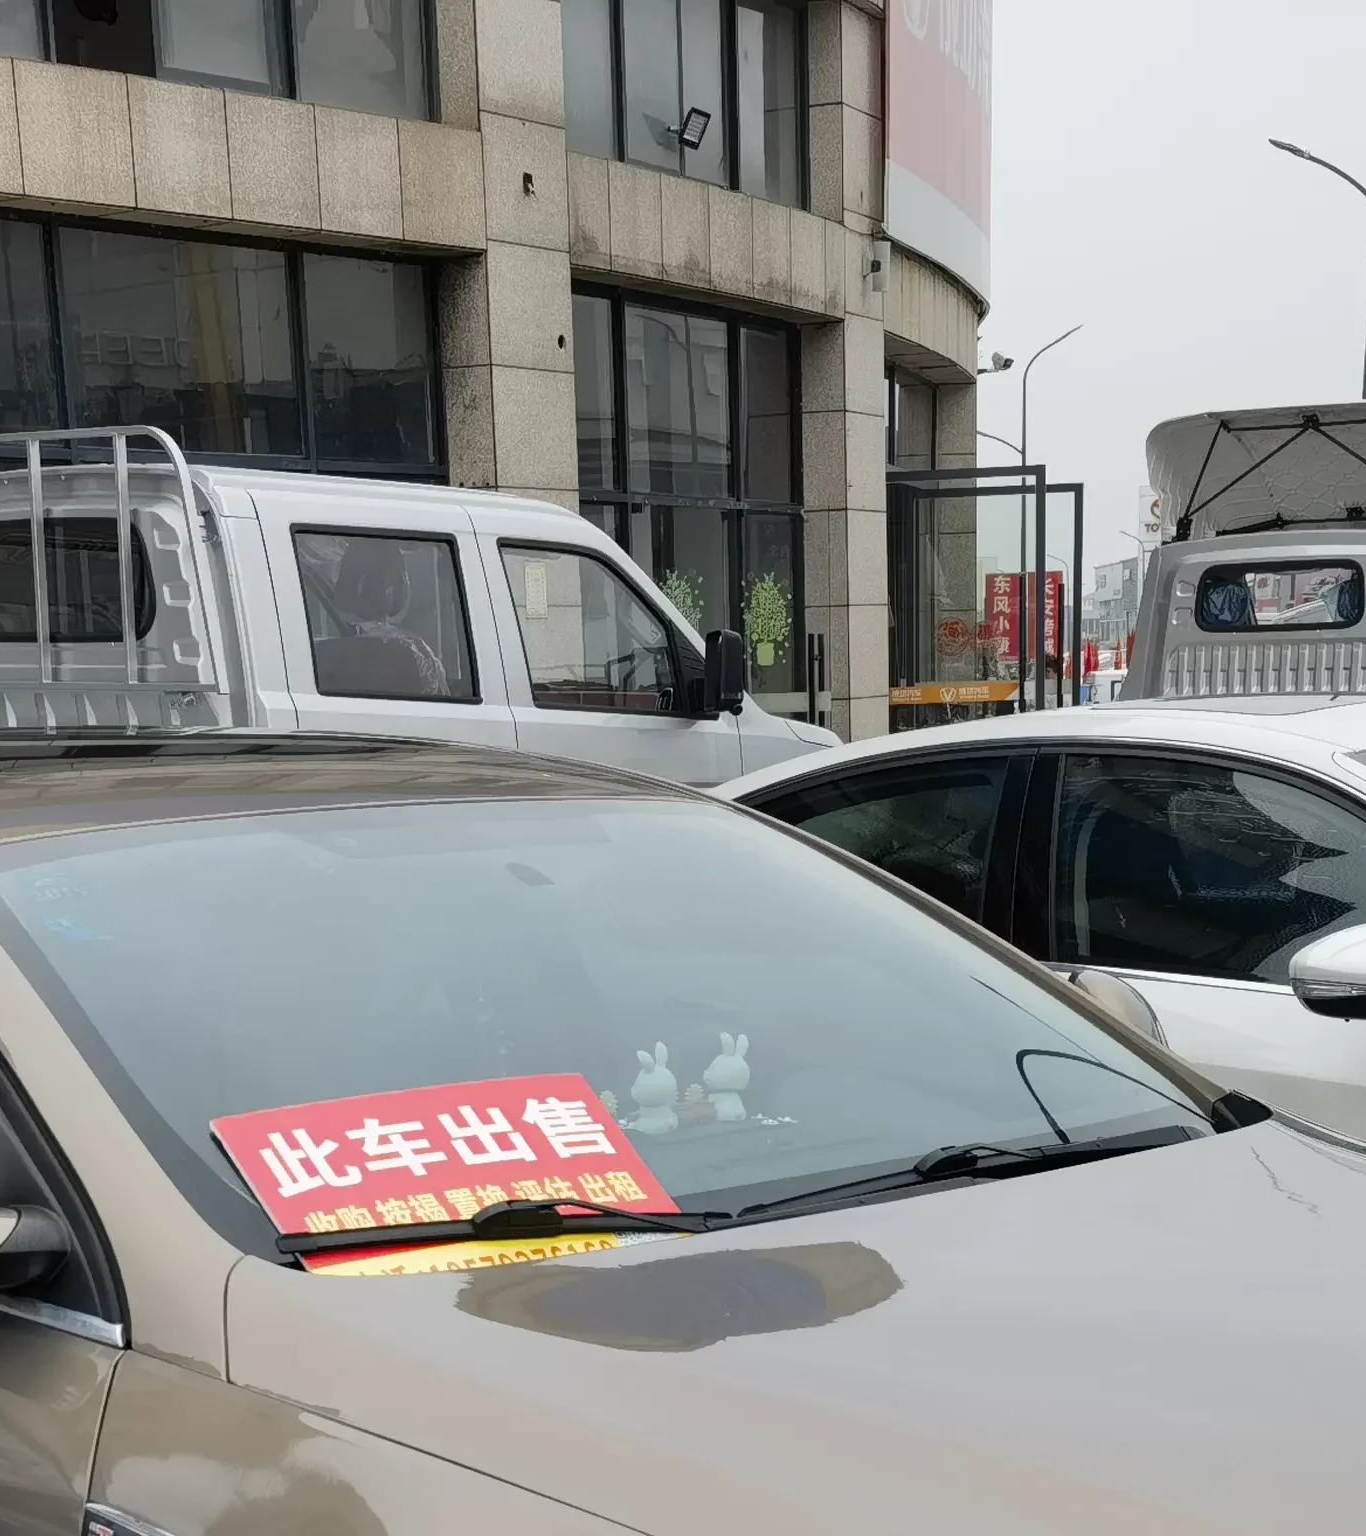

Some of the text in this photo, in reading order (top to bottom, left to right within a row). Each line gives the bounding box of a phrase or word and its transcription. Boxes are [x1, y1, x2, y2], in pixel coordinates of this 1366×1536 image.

[258, 1096, 618, 1198] 此车出售
[578, 1171, 649, 1204] 出租
